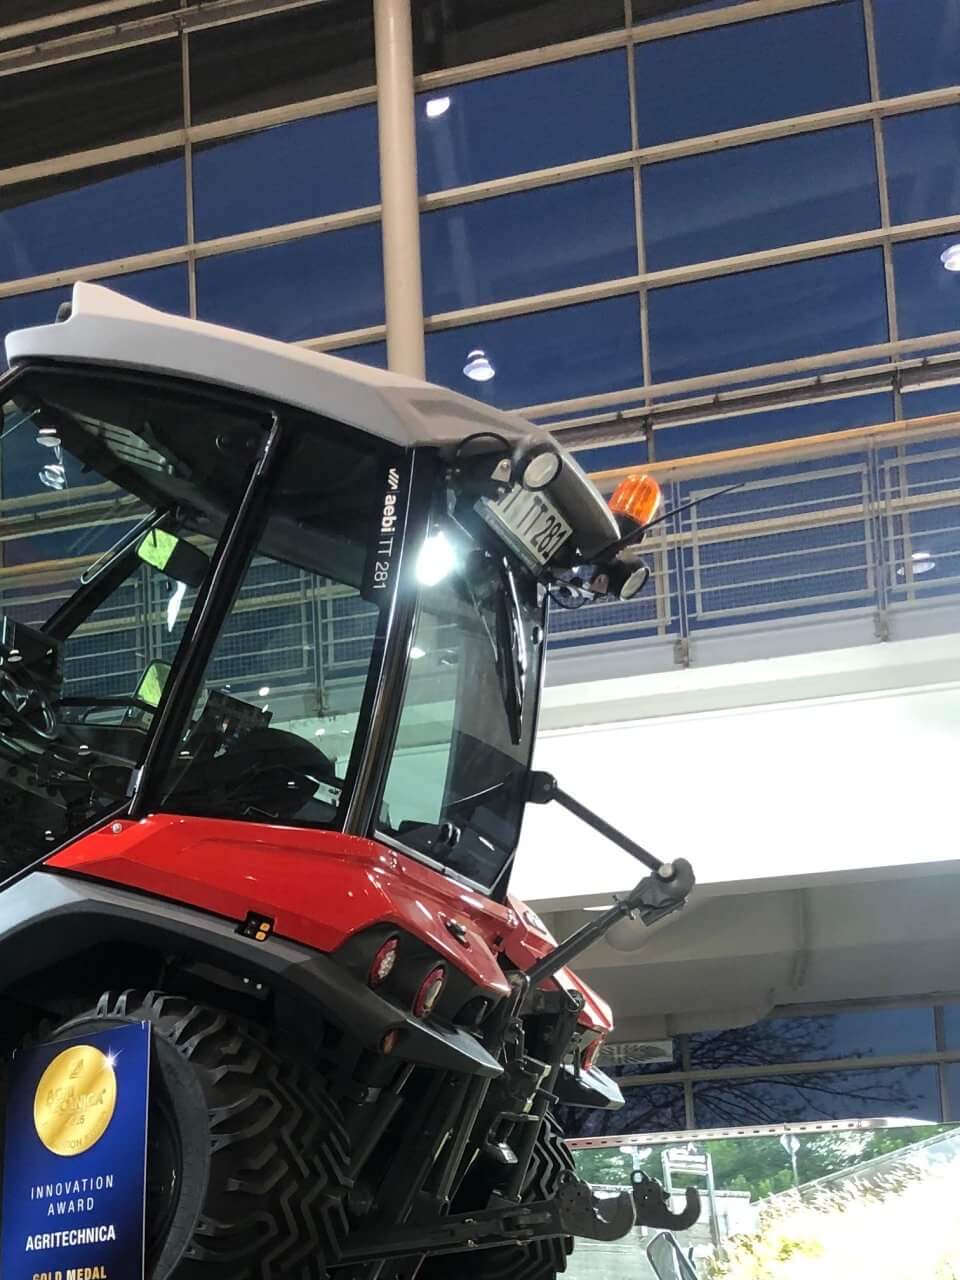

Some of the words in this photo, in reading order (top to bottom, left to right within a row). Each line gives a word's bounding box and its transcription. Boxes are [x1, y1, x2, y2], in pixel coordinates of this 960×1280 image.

[380, 495, 397, 533] aebi
[517, 496, 547, 536] TT
[532, 514, 568, 560] 281
[377, 537, 393, 557] TT
[373, 561, 389, 589] 281
[31, 1174, 114, 1200] INNOVATION
[47, 1197, 94, 1216] AWARD
[25, 1224, 116, 1251] AGRITECHNICA
